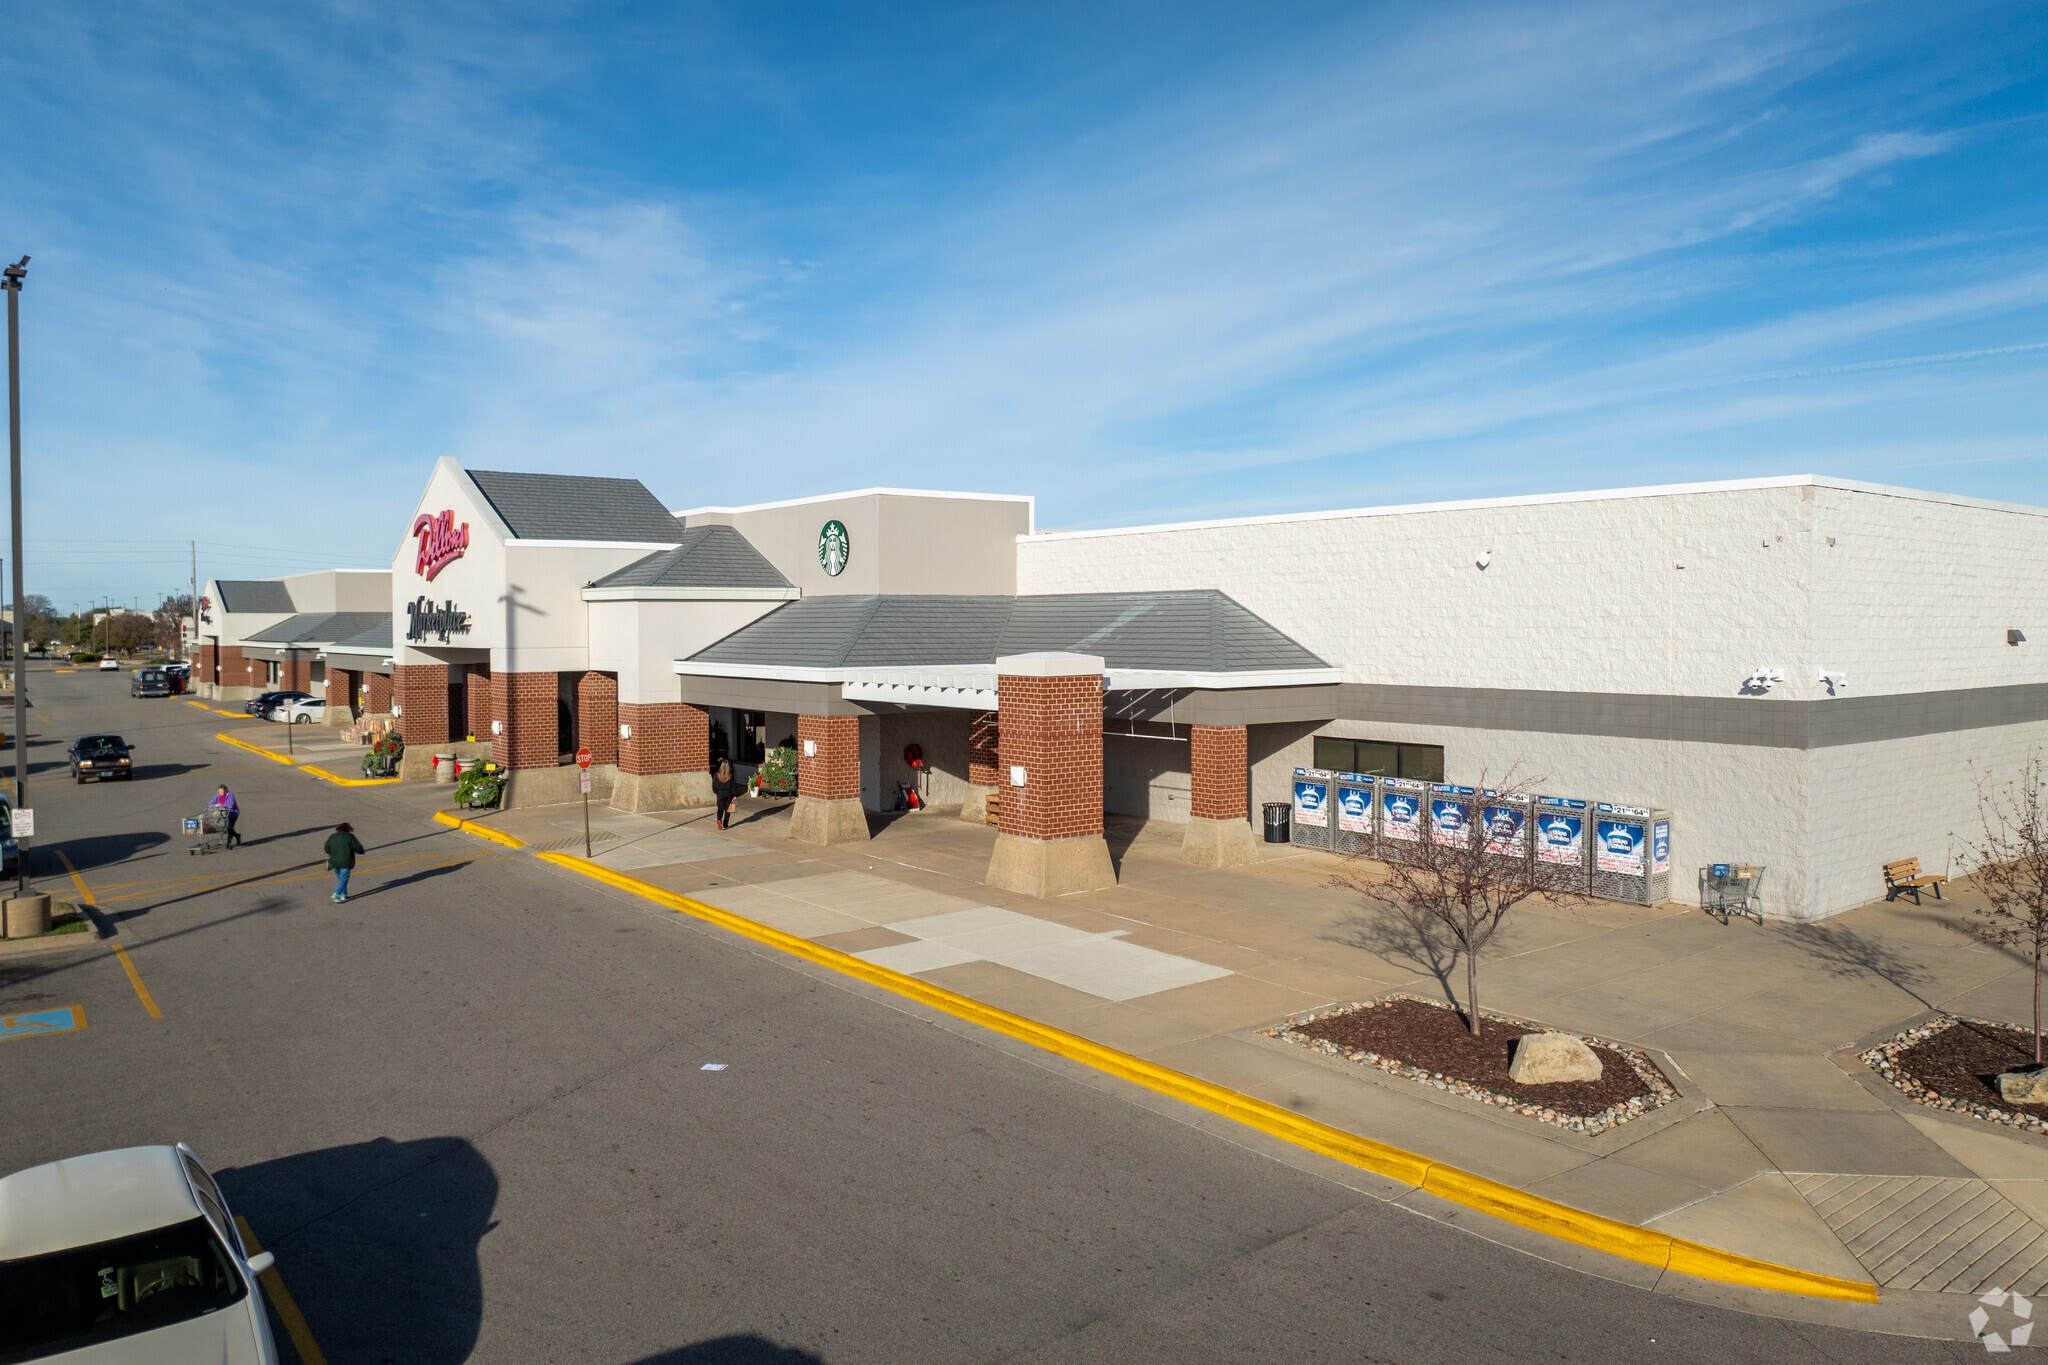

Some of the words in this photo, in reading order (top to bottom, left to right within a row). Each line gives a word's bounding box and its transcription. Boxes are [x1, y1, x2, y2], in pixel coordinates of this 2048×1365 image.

[413, 510, 469, 578] Dillons
[406, 596, 467, 645] Marketplace
[577, 753, 591, 764] STOP
